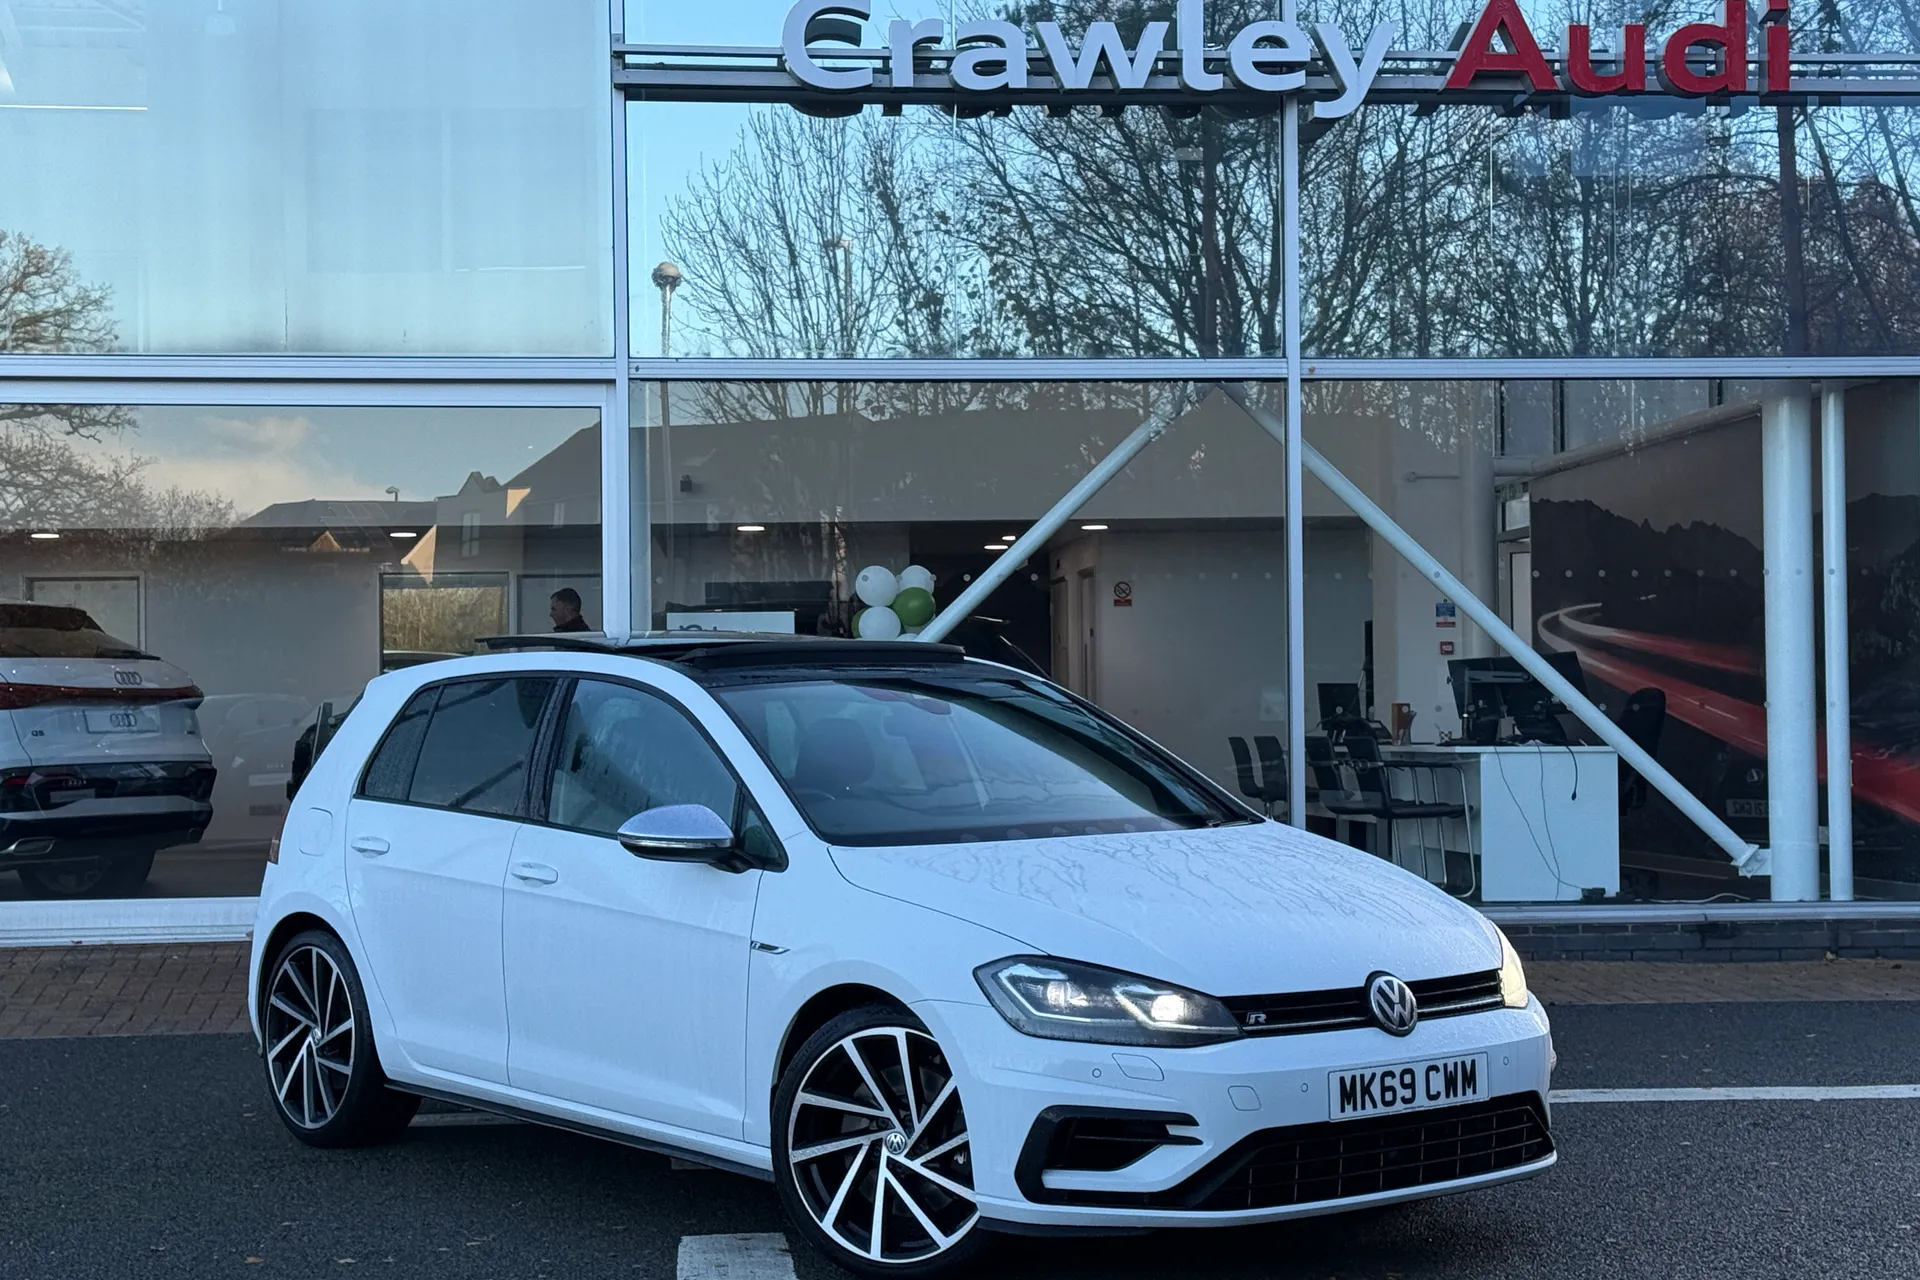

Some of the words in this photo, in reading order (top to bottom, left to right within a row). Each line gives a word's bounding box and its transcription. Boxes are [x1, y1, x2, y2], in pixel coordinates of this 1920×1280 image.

[780, 0, 1393, 119] Crawley
[1442, 0, 1790, 95] Audi
[1339, 1067, 1417, 1114] MK69
[1424, 1058, 1477, 1102] CWM
